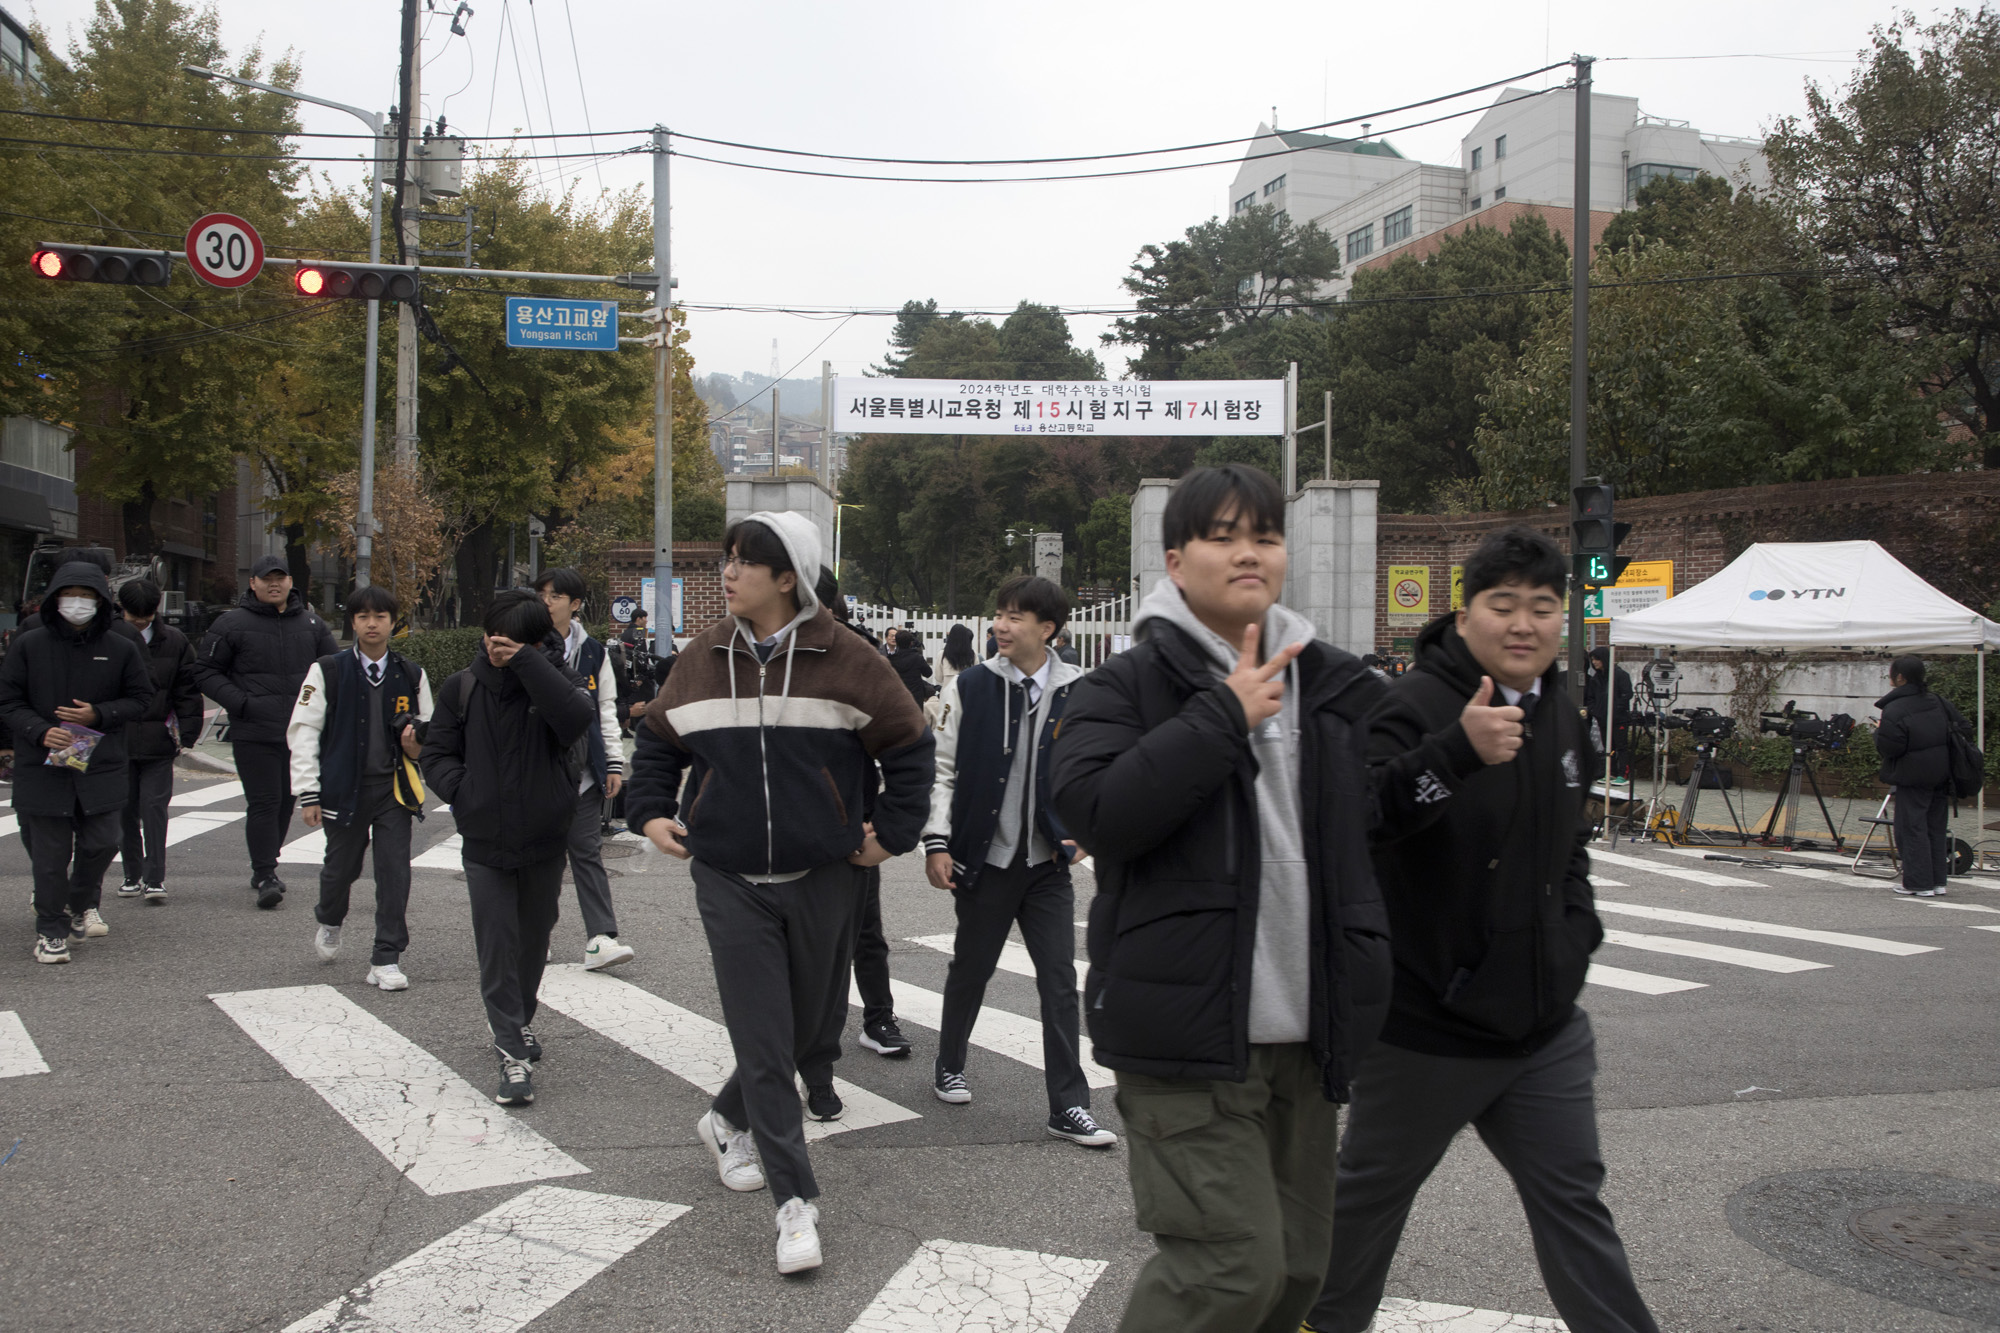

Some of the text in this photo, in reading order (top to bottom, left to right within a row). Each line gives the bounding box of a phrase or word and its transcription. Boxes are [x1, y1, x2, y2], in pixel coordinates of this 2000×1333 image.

[206, 231, 246, 271] 30
[516, 306, 609, 328] 용산고교앞
[520, 329, 598, 341] Yongsan H Sch'l
[960, 384, 1152, 397] 2024학년도 대학수학능력시험
[850, 397, 1262, 420] 서울특별시교육청 제15시험지구 제7시험장
[1039, 423, 1094, 432] 용산고등학교
[1791, 587, 1845, 600] YTN
[395, 696, 410, 713] B
